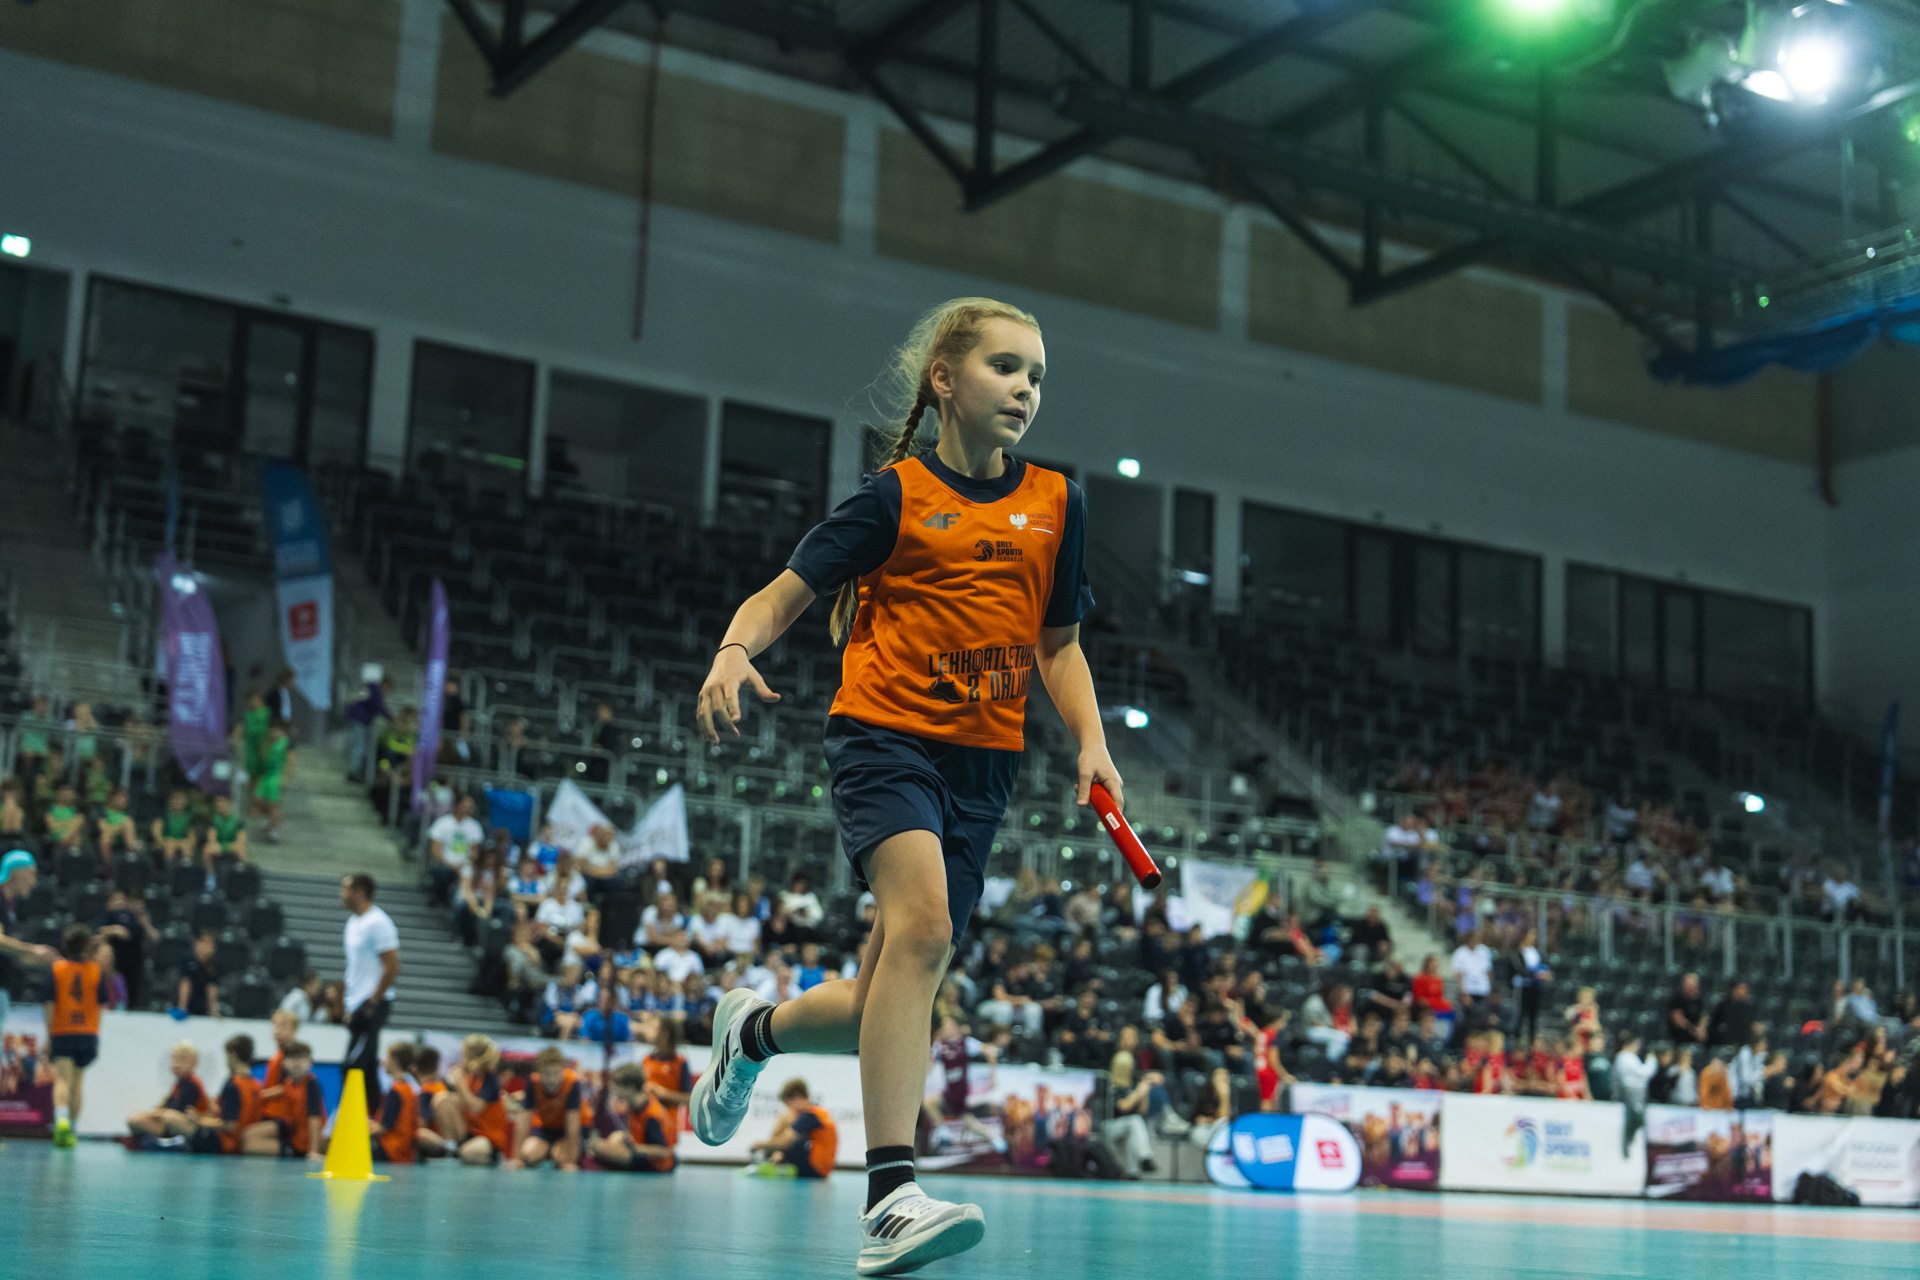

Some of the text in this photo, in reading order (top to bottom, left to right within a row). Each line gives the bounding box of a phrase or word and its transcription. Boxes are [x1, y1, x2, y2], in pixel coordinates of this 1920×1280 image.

[923, 512, 961, 530] 4F
[927, 643, 1036, 677] LEKKOATLETYK
[990, 669, 1031, 702] ORLIK
